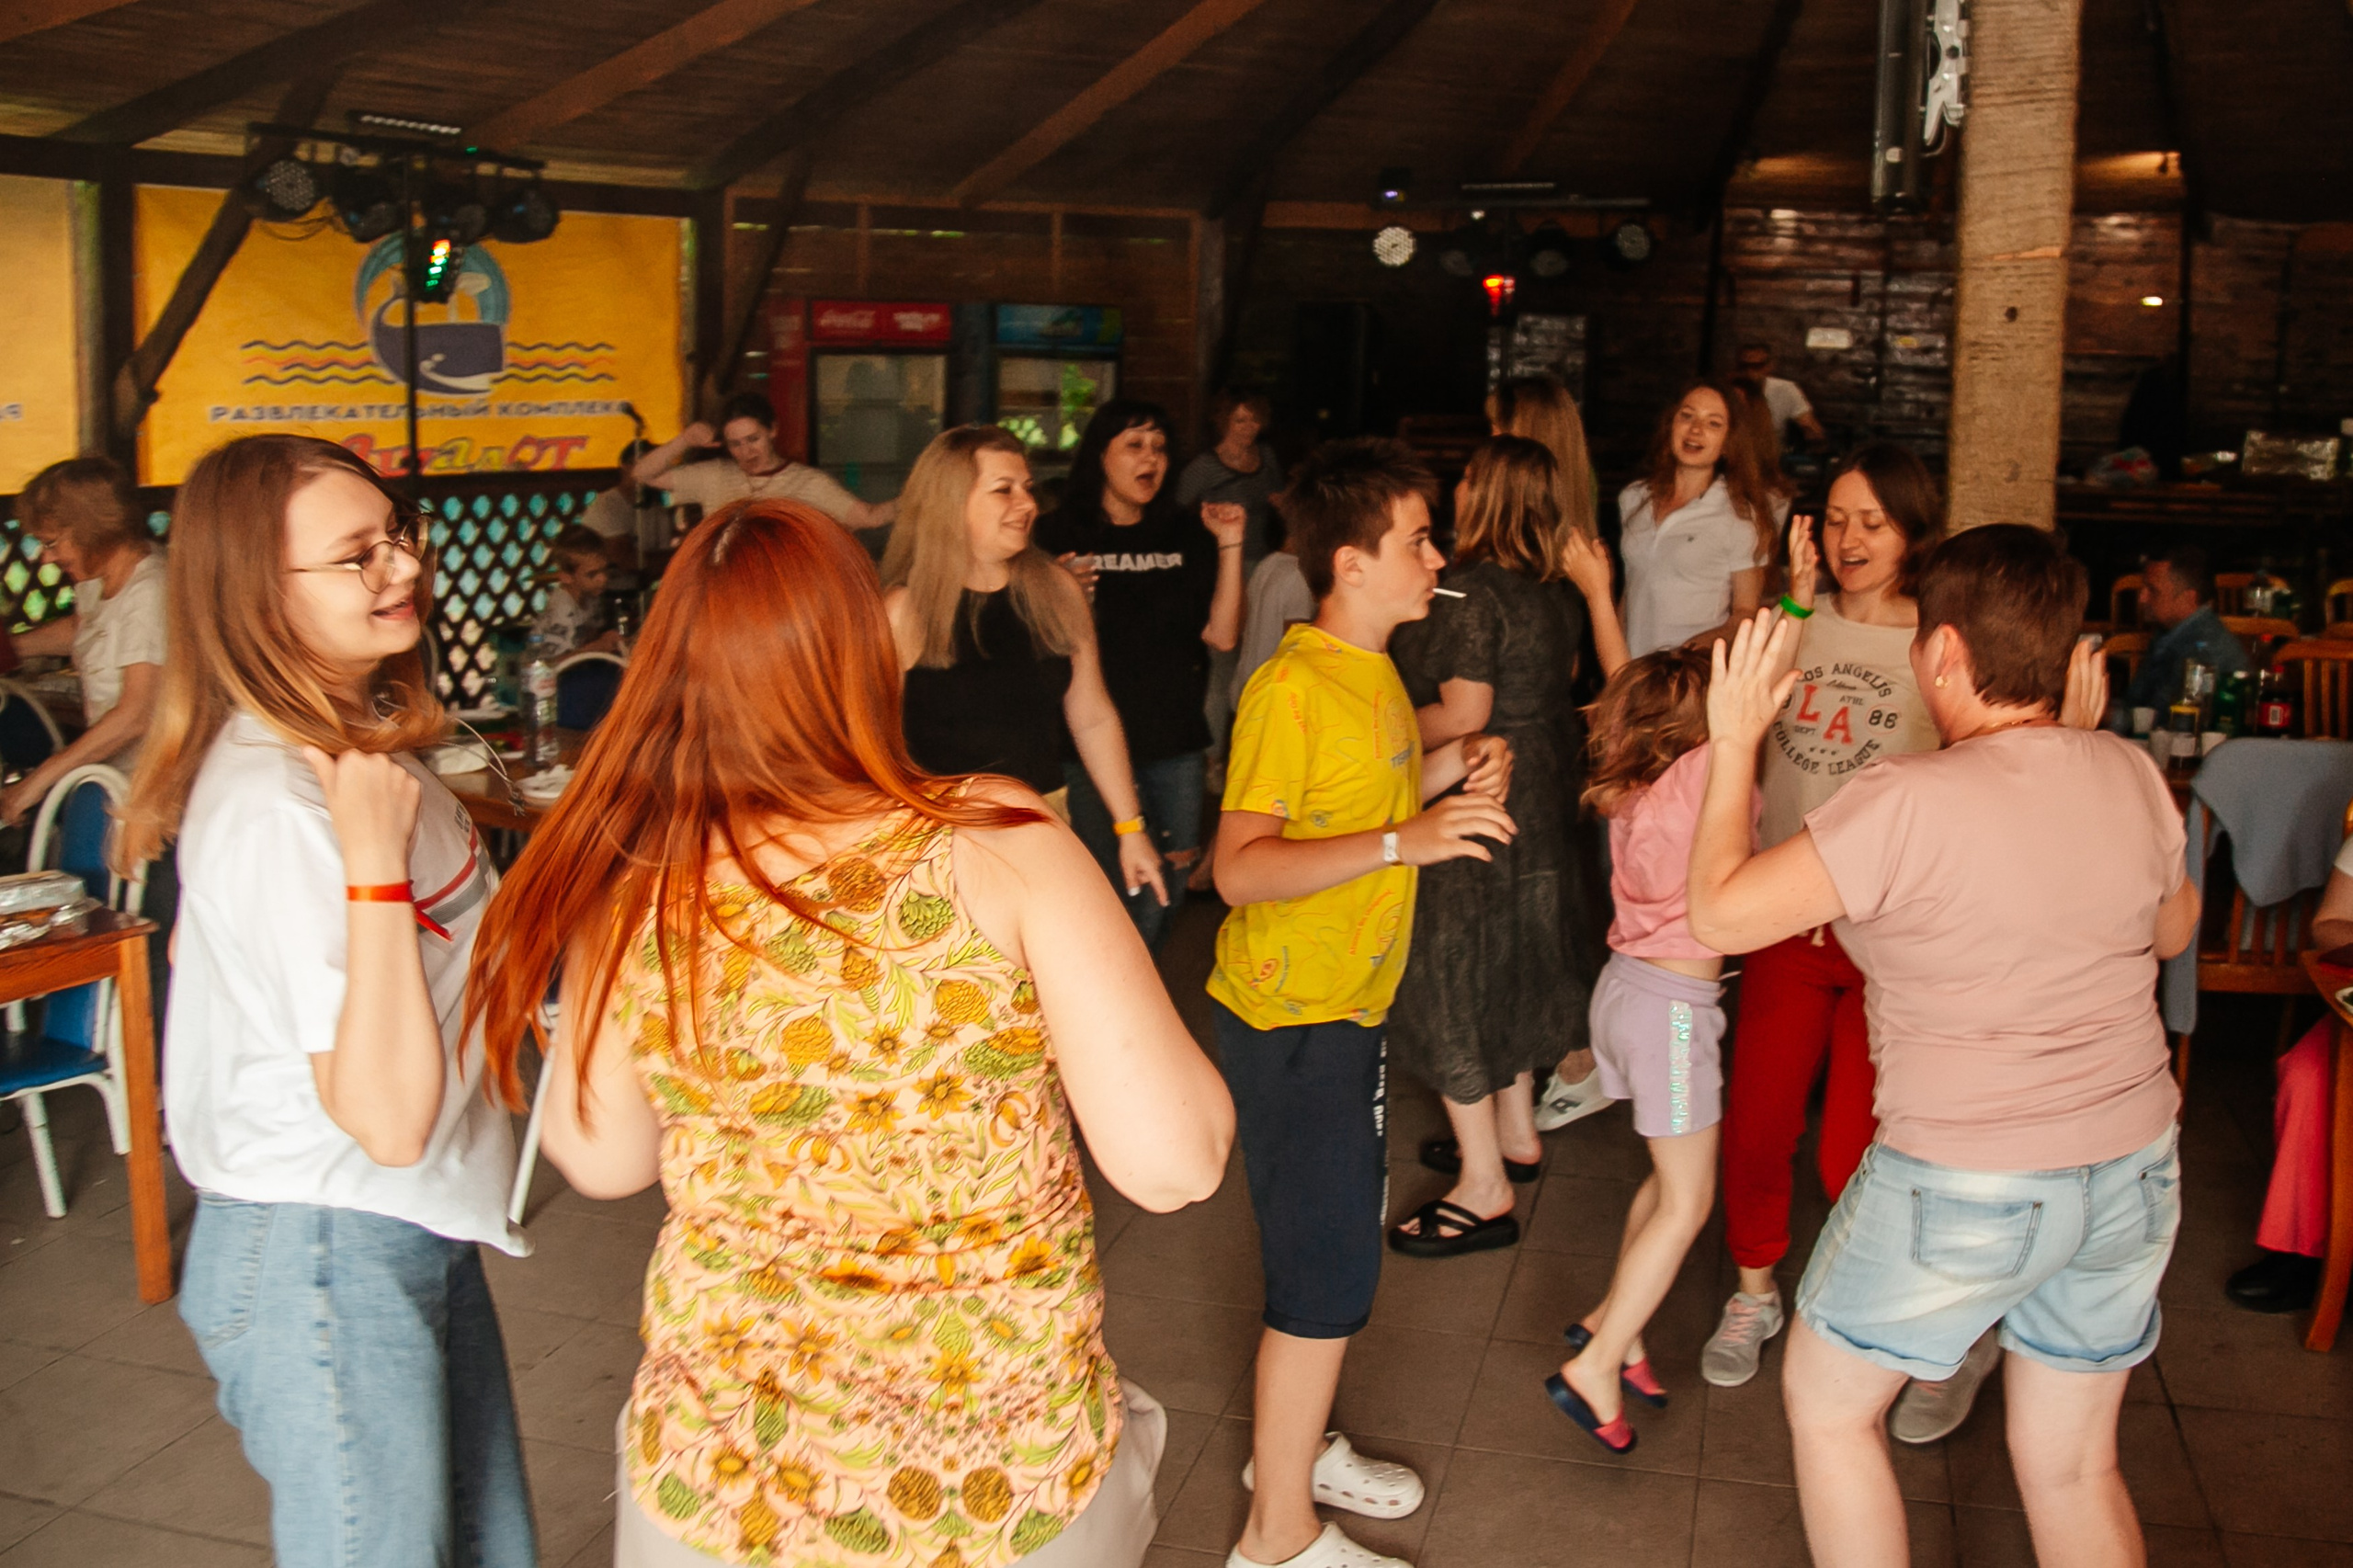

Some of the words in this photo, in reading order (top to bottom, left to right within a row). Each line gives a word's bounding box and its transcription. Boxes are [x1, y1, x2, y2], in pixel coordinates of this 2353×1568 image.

[1869, 710, 1899, 730] 86
[1772, 721, 1821, 775] COLLEGE
[1828, 738, 1881, 776] LEAGUE
